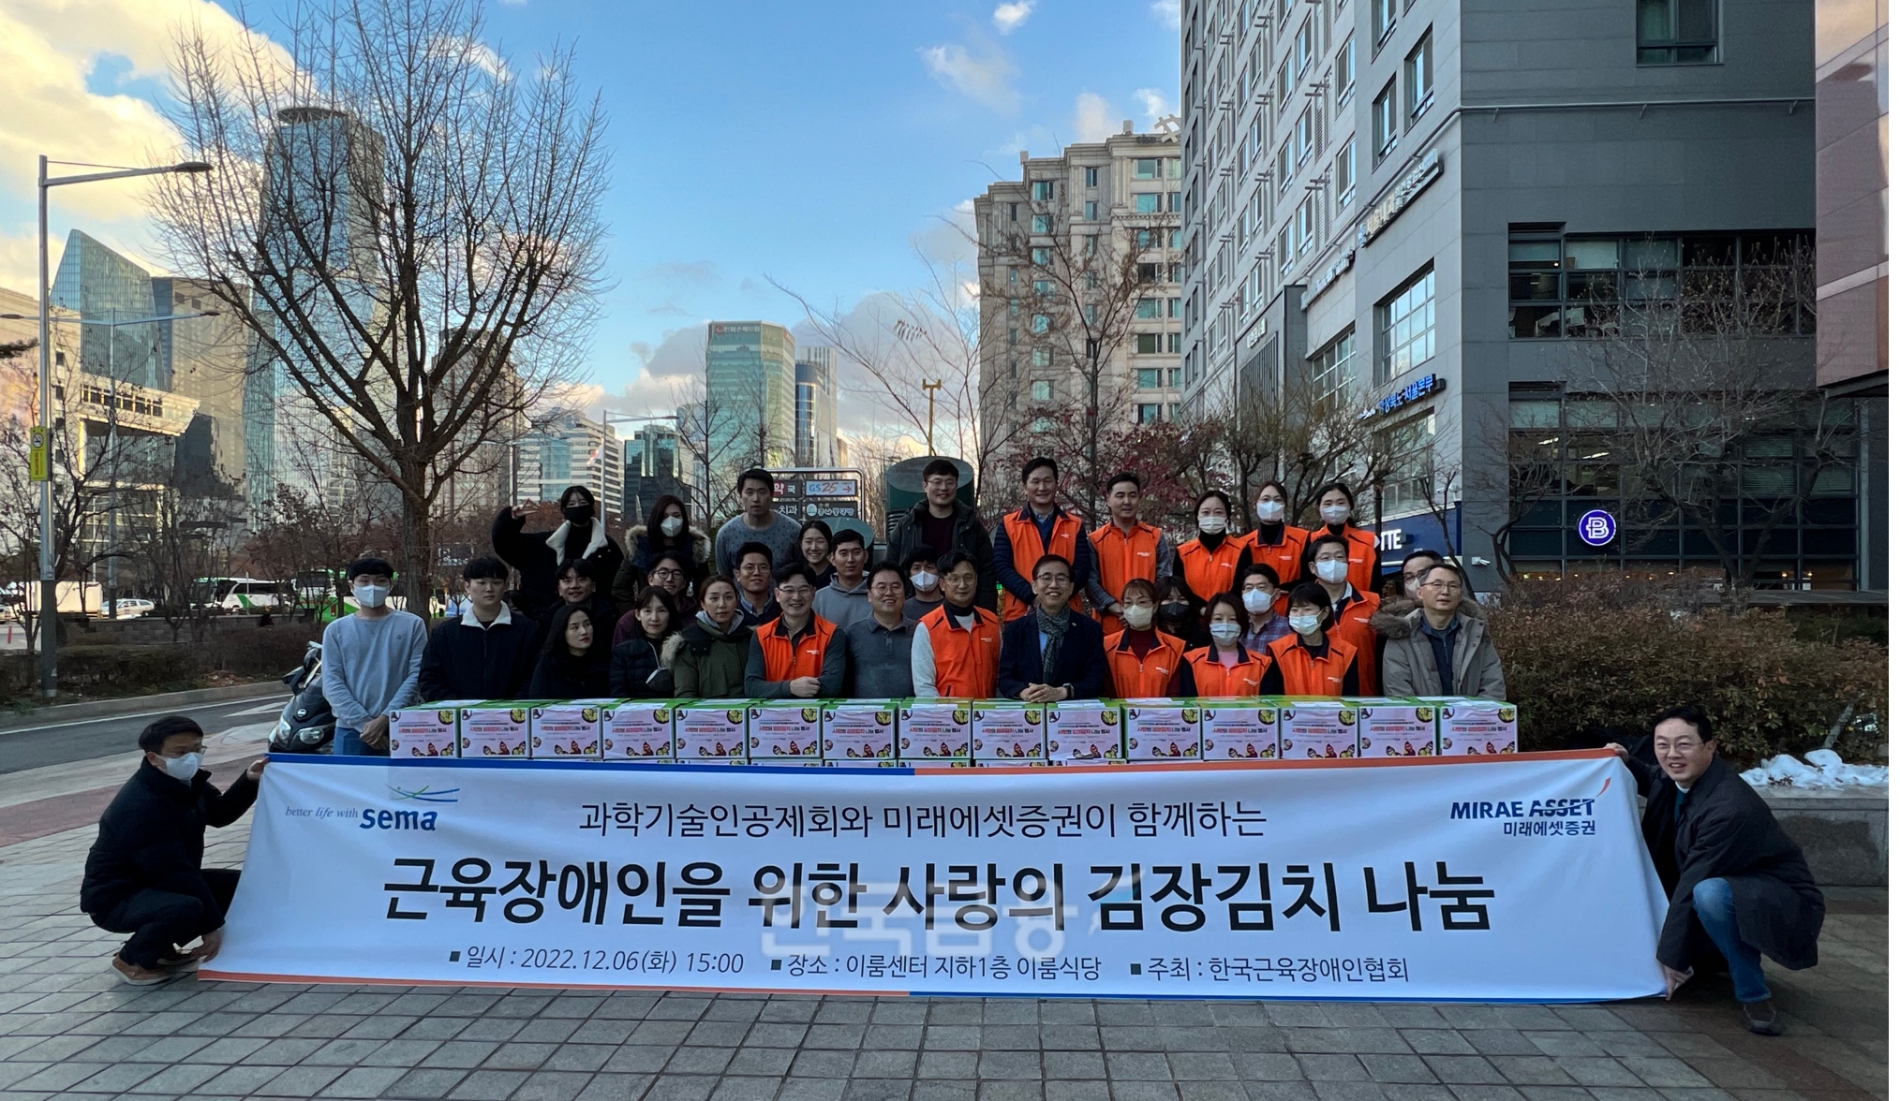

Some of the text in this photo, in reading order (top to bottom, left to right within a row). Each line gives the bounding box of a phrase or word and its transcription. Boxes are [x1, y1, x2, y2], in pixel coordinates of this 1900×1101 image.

[285, 806, 438, 832] better life with sema
[580, 802, 1267, 838] 과학기술인공제회와 미래에셋증권이 함께하는
[1450, 799, 1596, 820] MIRAE ASSET
[1503, 820, 1596, 837] 미래에셋증권
[384, 858, 1495, 933] 근육장애인을 위한 사랑의 김장김치 나눔
[467, 946, 505, 969] 일시
[520, 948, 677, 973] 2022.12.06(화)
[687, 952, 744, 973] 15:00
[788, 954, 828, 977] 장소
[846, 954, 928, 978] 이룸센터
[934, 955, 1012, 980] 지하1층
[1016, 956, 1102, 981] 이룸식당
[1148, 957, 1191, 981] 주최
[1208, 957, 1409, 983] 한국근육장애인협회
